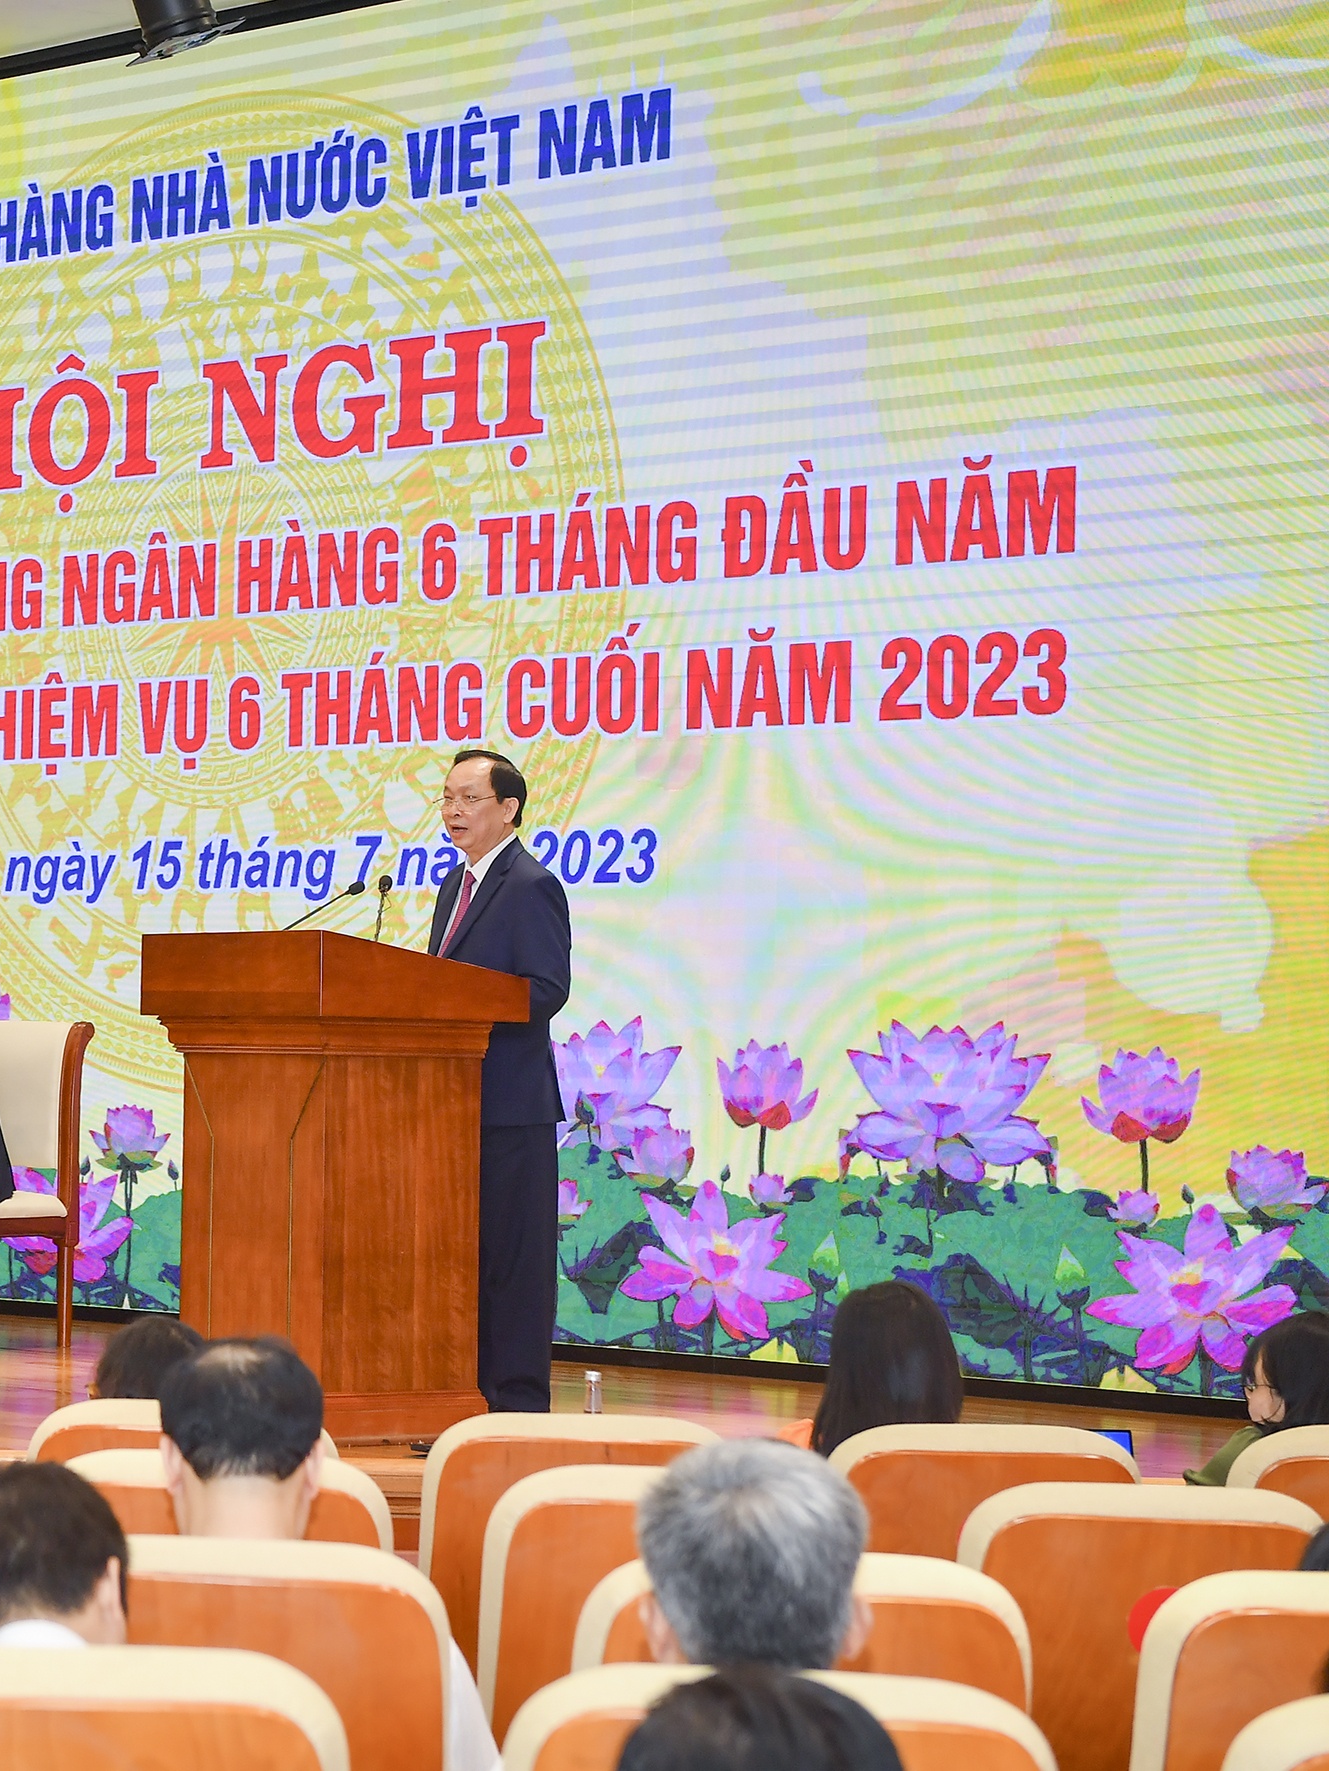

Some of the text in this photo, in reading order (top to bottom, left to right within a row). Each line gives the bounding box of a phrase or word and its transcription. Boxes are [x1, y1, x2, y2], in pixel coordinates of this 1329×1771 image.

[131, 151, 231, 244] NHÀ
[248, 129, 388, 226] NƯỚC
[406, 105, 520, 208] VIỆT
[538, 87, 672, 180] NAM
[201, 321, 545, 468] NGHỊ
[63, 532, 217, 626] NGÂN
[238, 520, 399, 613] HÀNG
[422, 523, 457, 600] 6
[479, 493, 697, 595] THÁNG
[722, 460, 867, 578] ĐẦU
[896, 456, 1076, 565] NĂM
[139, 679, 208, 769] VỤ
[229, 676, 261, 750] 6
[282, 652, 483, 747] THÁNG
[507, 623, 660, 738] CUỐI
[687, 628, 852, 729] NĂM
[879, 629, 1067, 721] 2023
[5, 841, 116, 905] ngày
[132, 840, 183, 890] 15
[198, 836, 336, 902] tháng
[355, 835, 383, 884] 7
[396, 832, 461, 887] nă
[532, 828, 658, 884] 2023
